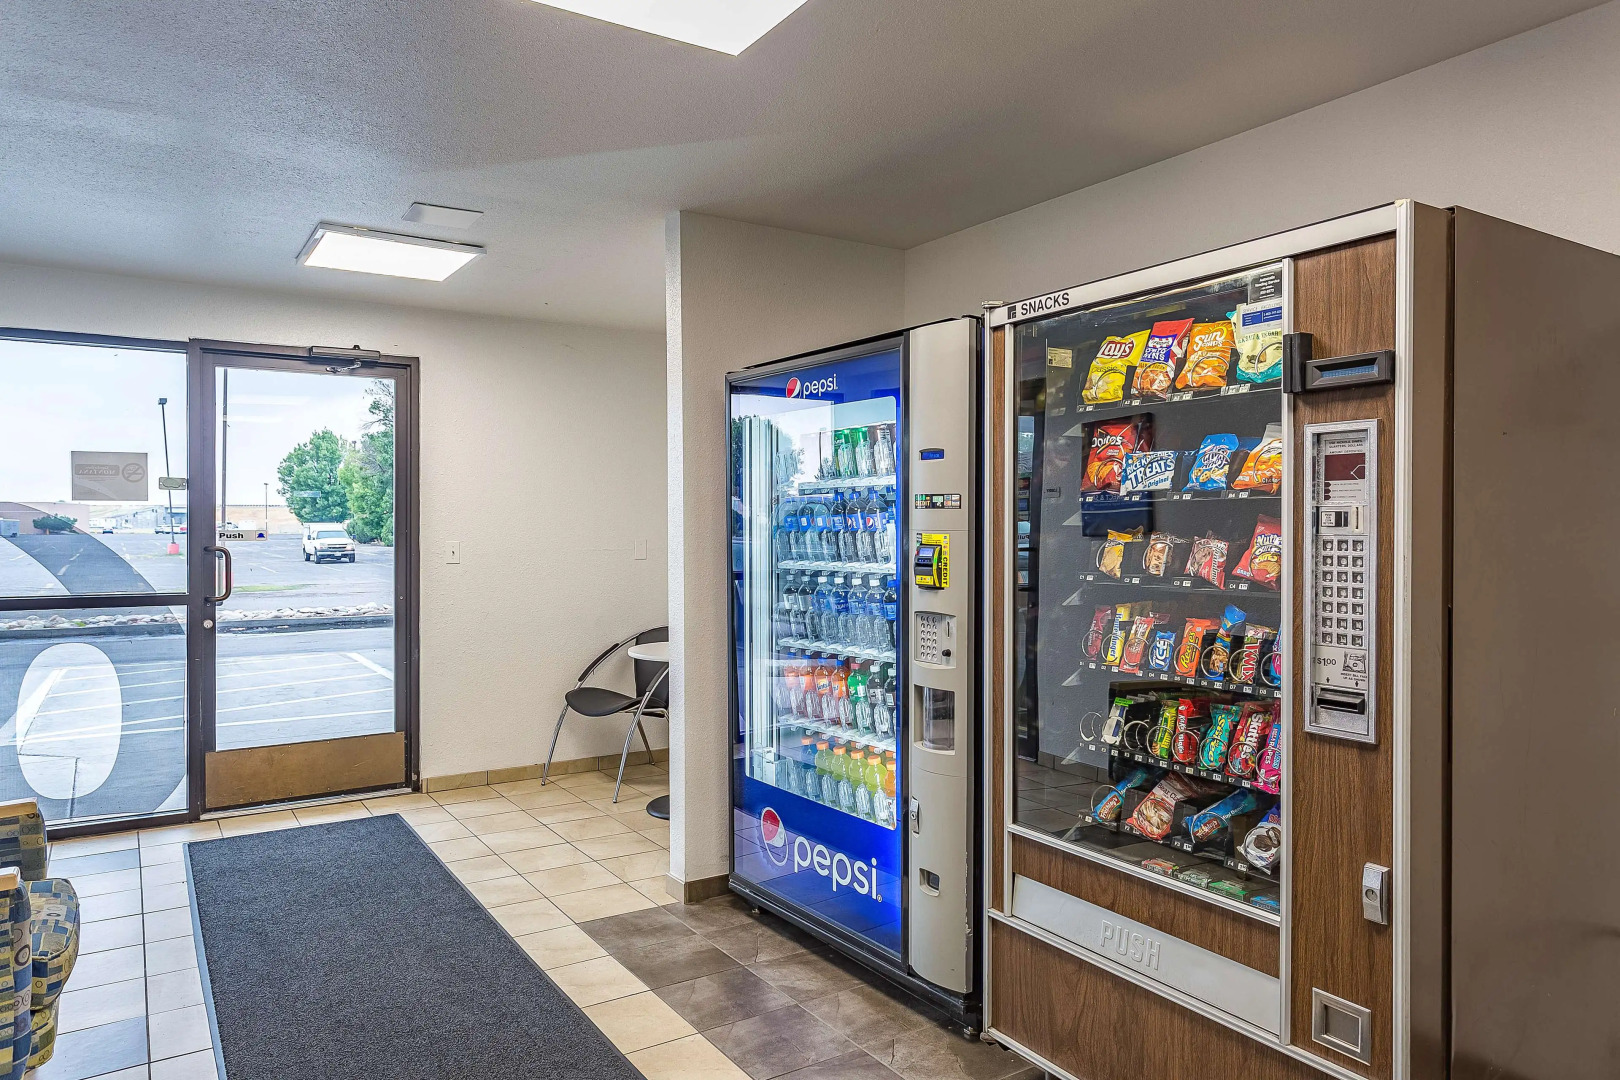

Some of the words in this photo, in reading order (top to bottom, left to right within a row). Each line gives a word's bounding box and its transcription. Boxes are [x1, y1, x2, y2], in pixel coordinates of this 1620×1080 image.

[1021, 292, 1070, 316] SNACKS
[1194, 330, 1224, 351] Sun
[803, 374, 837, 399] pepsi
[1126, 460, 1141, 474] RICE
[1129, 459, 1175, 489] TREATS
[1148, 476, 1169, 488] Original
[1242, 639, 1261, 683] TWIX
[1317, 658, 1336, 666] $1.00
[1240, 713, 1263, 759] Skittles
[1157, 782, 1170, 795] Bear
[794, 836, 877, 900] pepsi
[1101, 920, 1160, 970] PUSH
